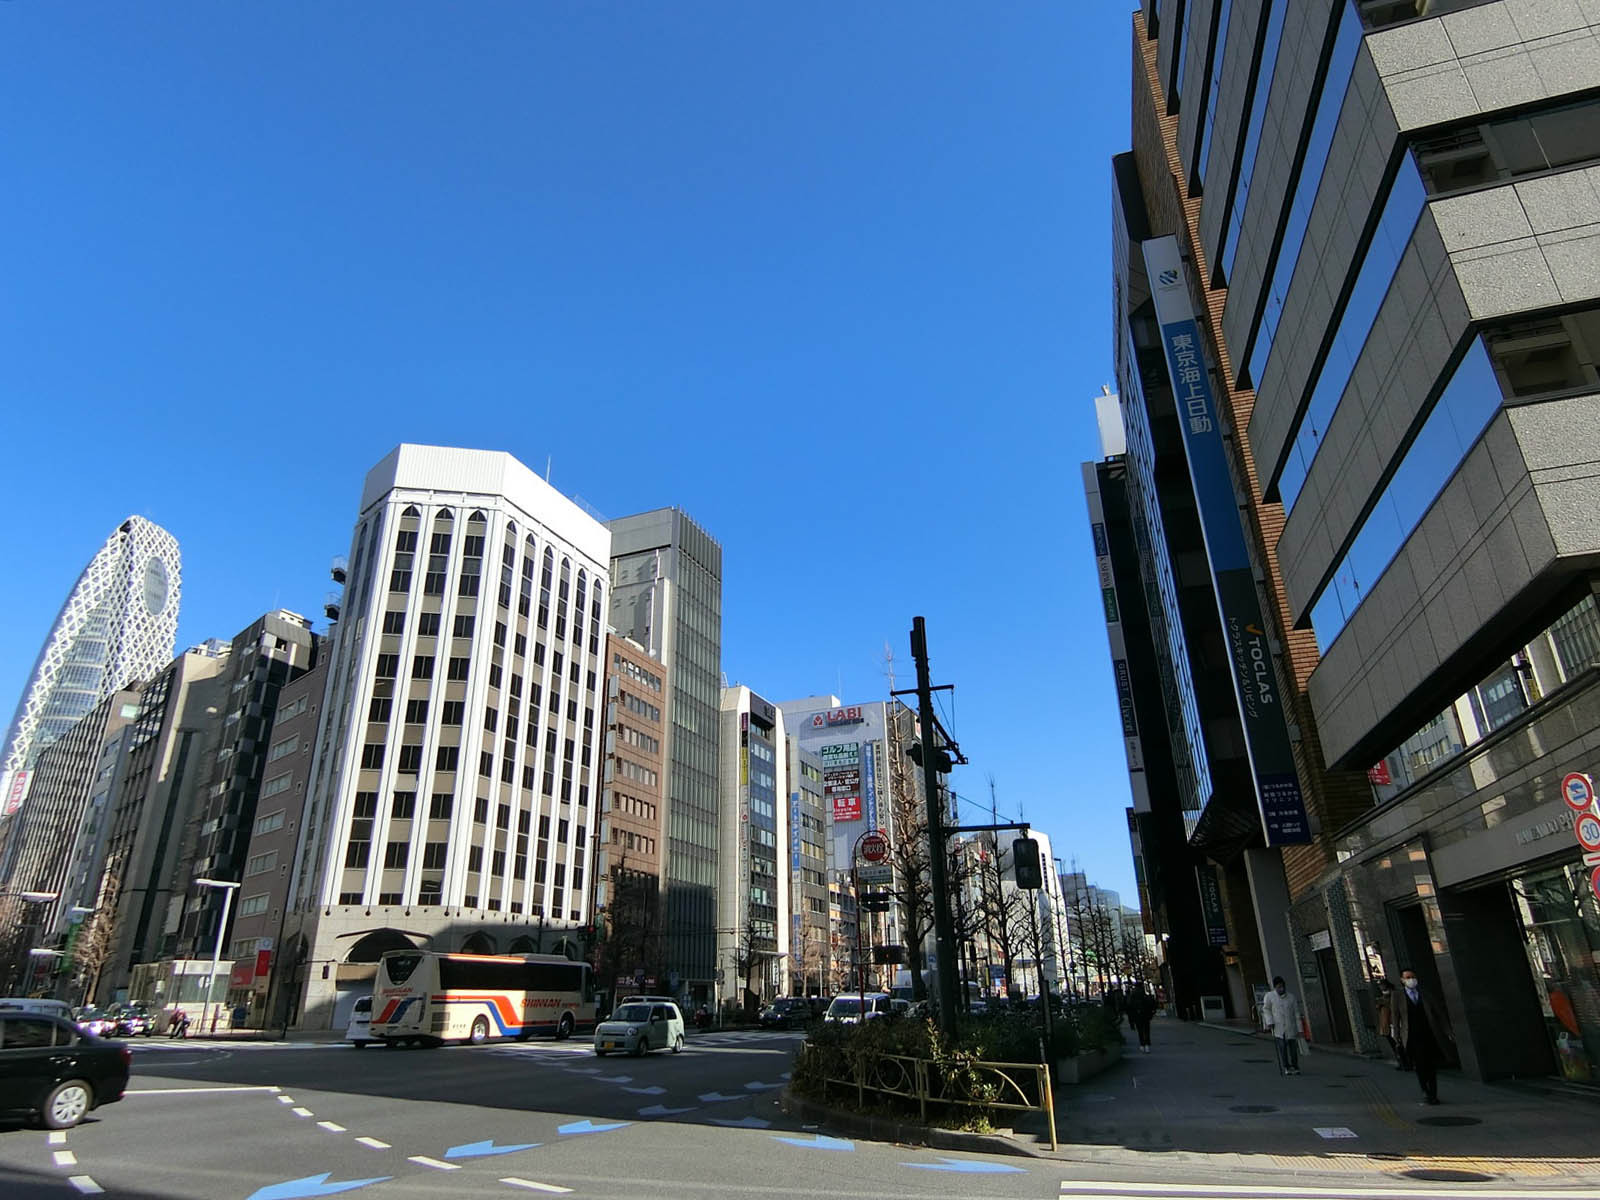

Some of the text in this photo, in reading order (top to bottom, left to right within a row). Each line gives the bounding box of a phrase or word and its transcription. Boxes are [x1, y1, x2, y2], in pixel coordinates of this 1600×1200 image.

[1171, 333, 1212, 435] 東京海上日動
[1249, 636, 1272, 704] TOCLAS
[827, 706, 862, 722] LABI
[1583, 823, 1600, 841] 30
